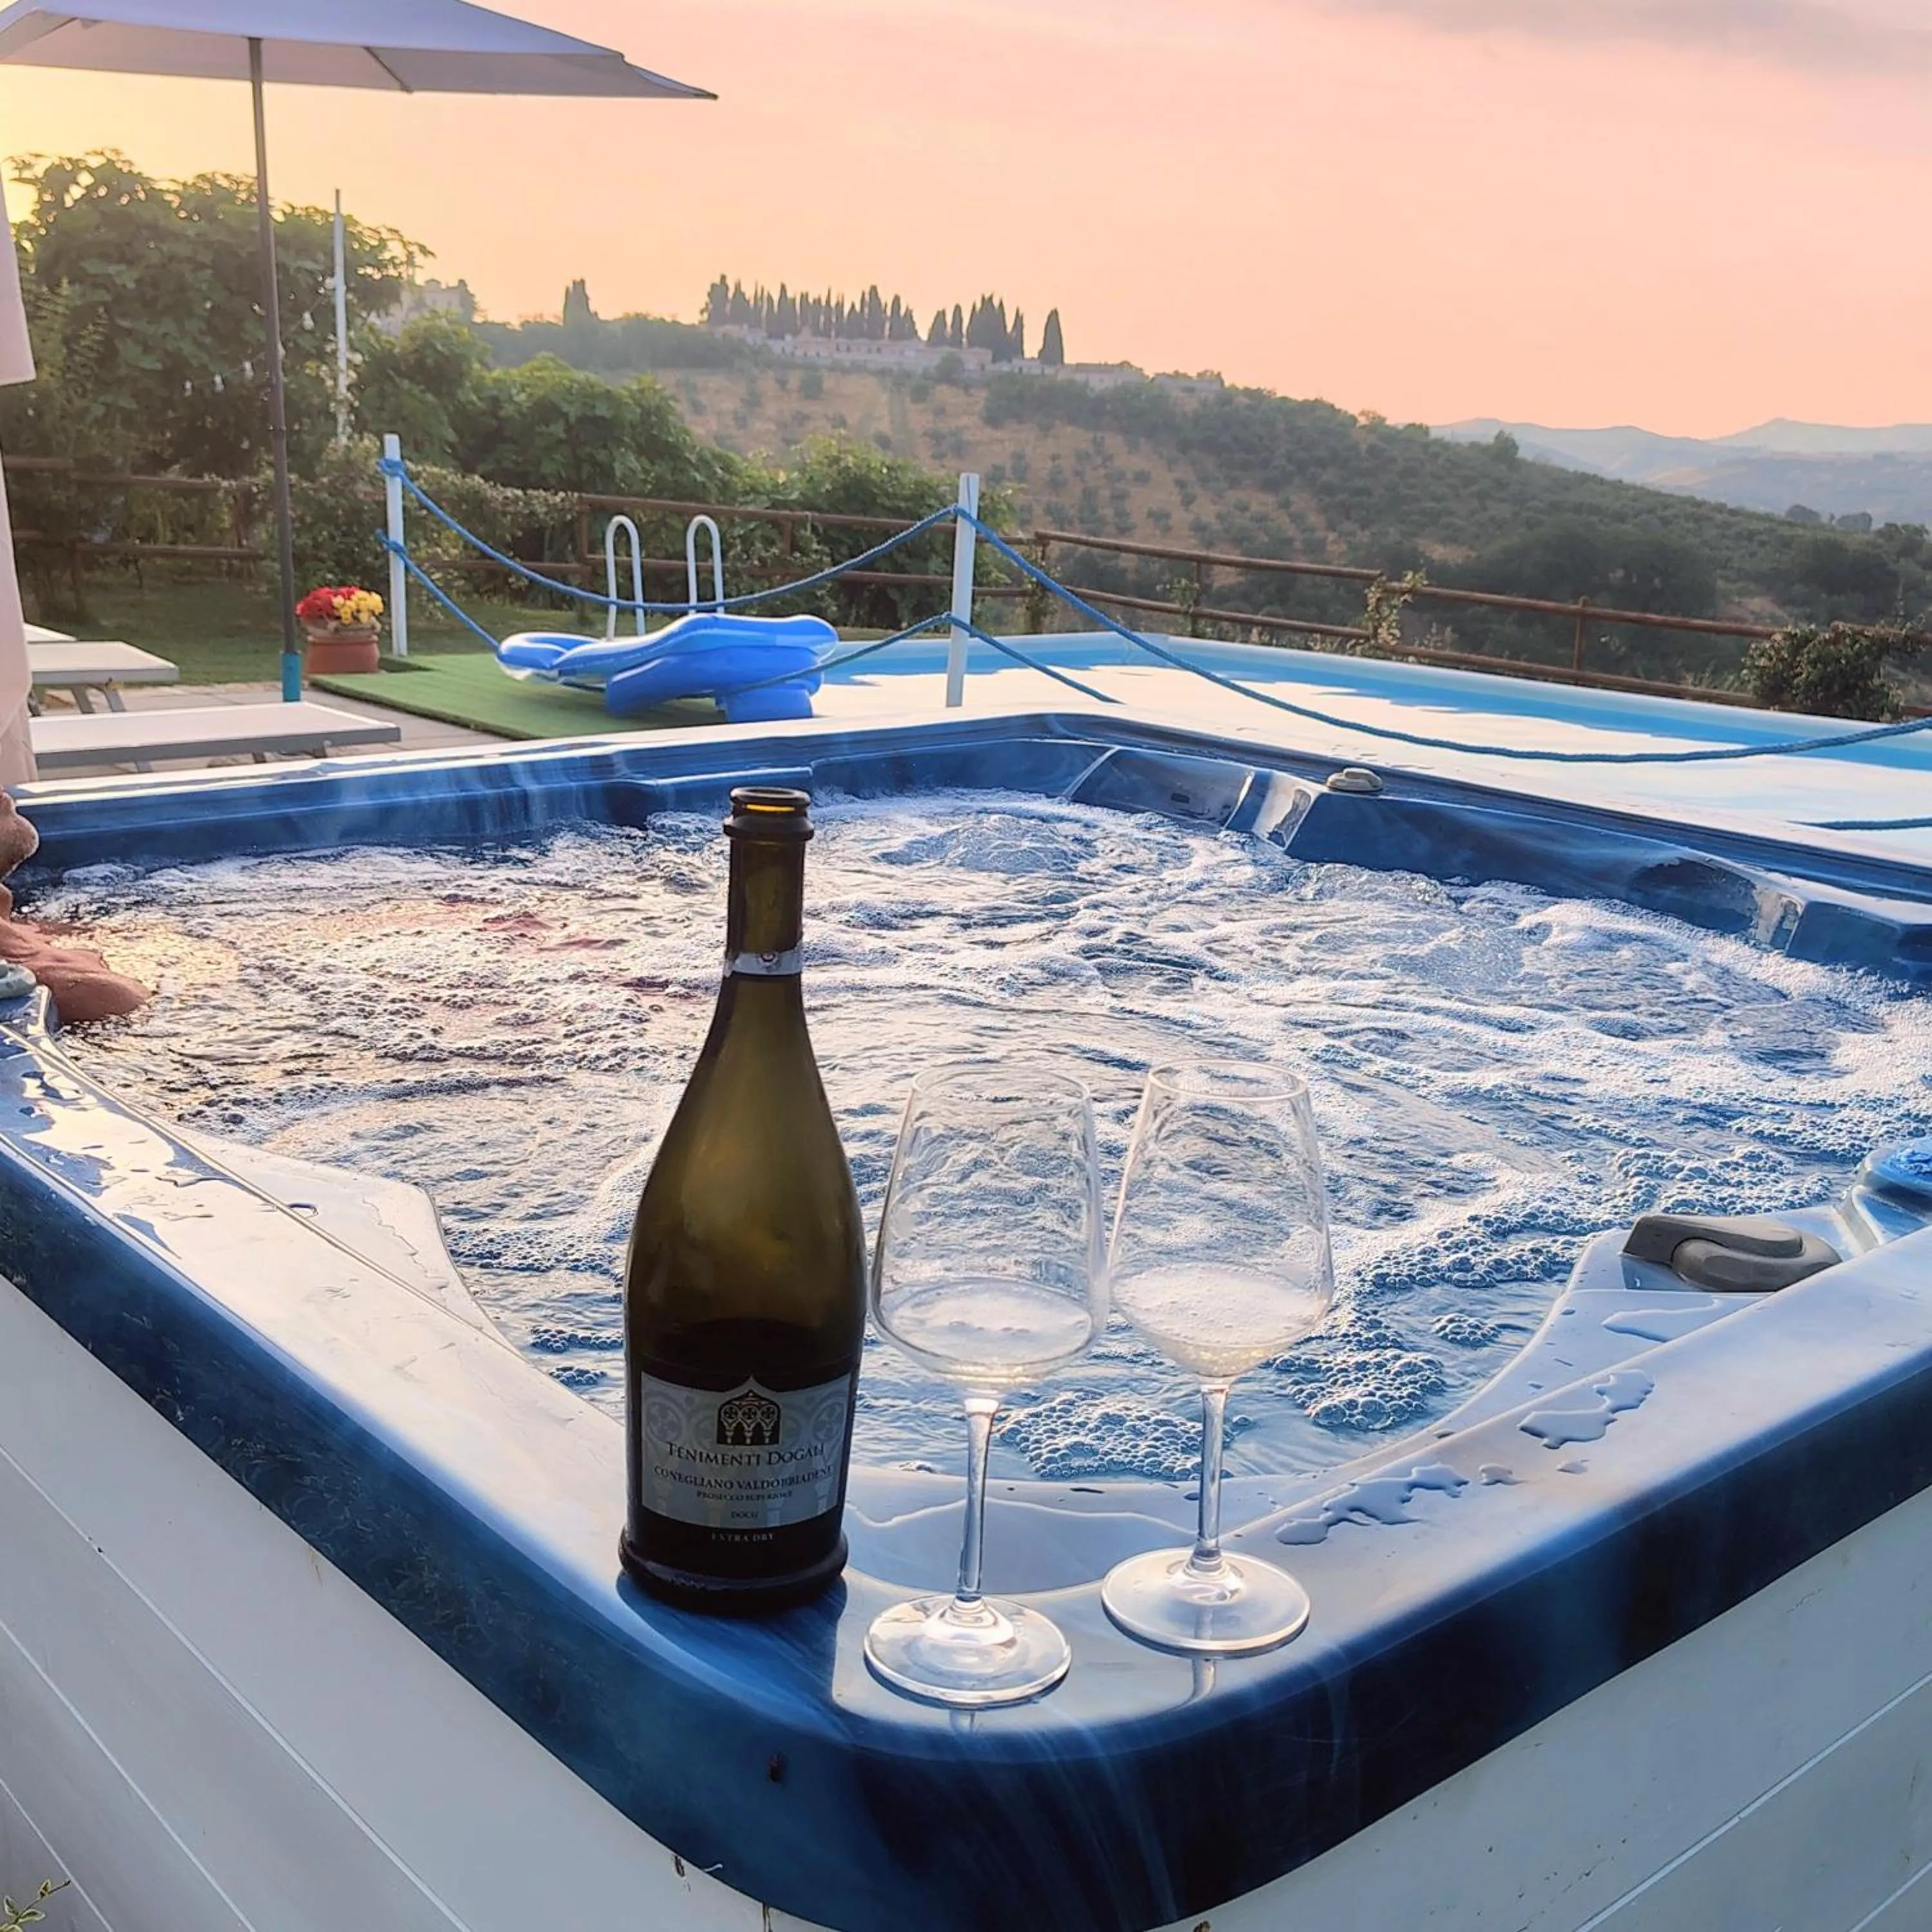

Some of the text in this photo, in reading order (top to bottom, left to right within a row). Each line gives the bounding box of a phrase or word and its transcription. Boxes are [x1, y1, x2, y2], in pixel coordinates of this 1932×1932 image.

[667, 1441, 825, 1466] TENIMENTI DOGALI
[654, 1465, 734, 1490] CONEGLIANO
[711, 1532, 775, 1542] EXTRA DRY
